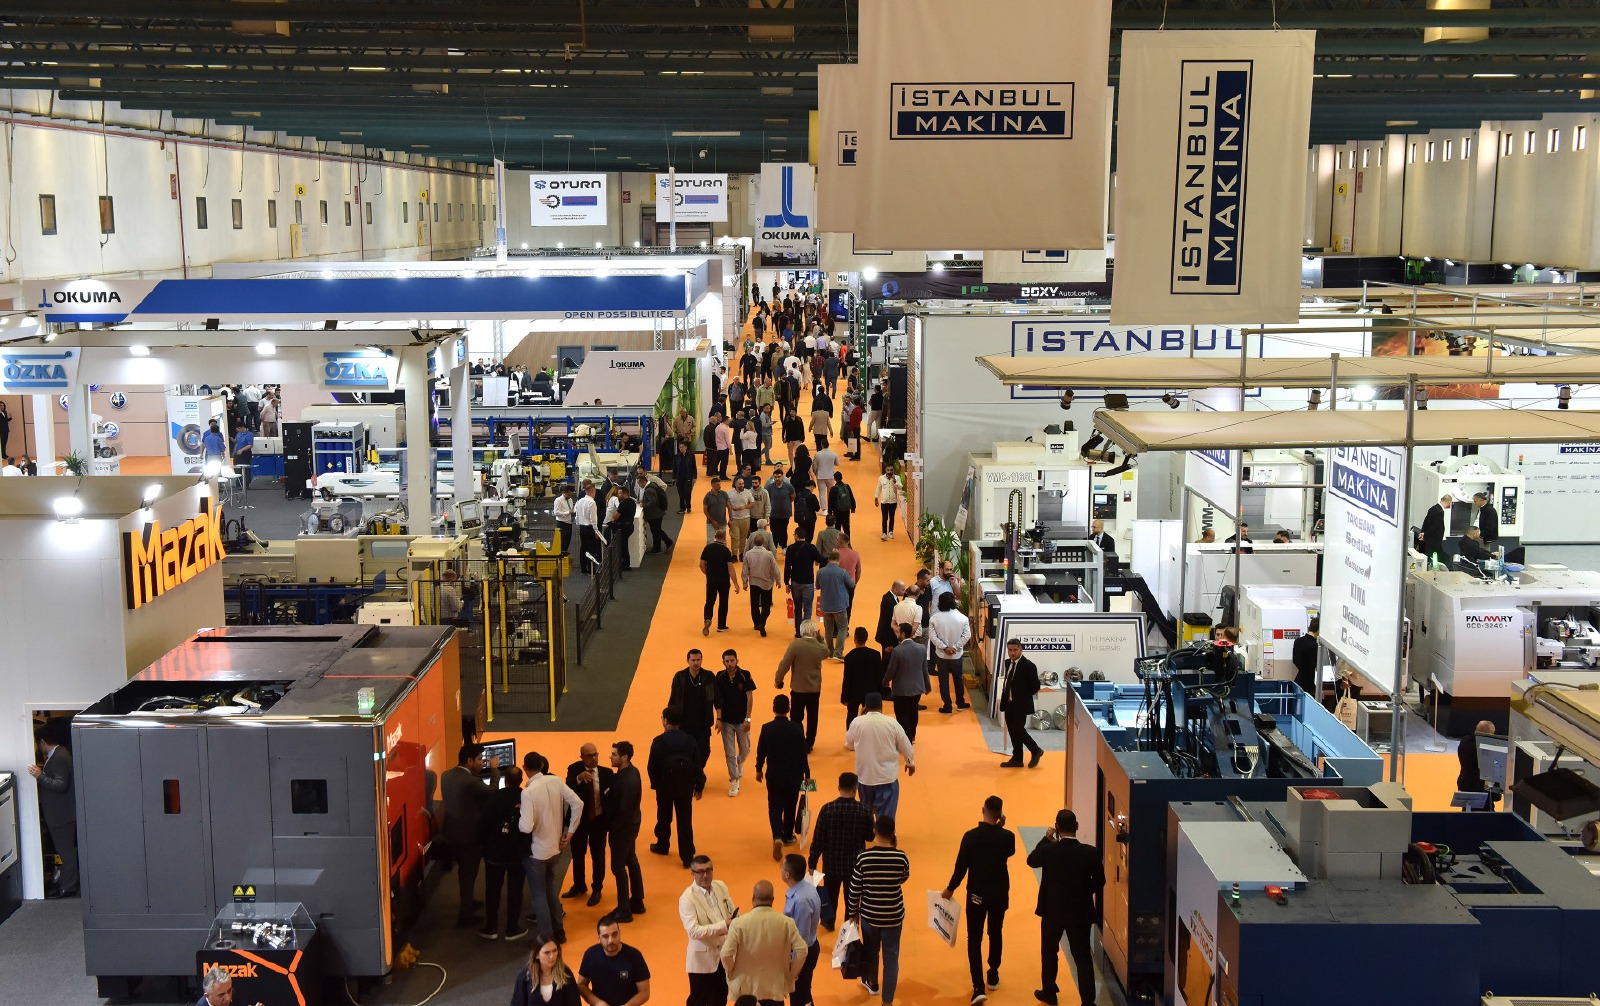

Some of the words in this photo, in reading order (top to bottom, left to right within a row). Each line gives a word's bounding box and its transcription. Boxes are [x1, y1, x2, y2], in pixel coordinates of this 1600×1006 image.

[901, 87, 1061, 107] İSTANBUL
[915, 112, 1048, 132] MAKİNA
[549, 180, 602, 189] OTURN
[1177, 75, 1210, 281] İSTANBUL
[1213, 93, 1242, 261] MAKİNA
[298, 187, 304, 195] 8
[1338, 185, 1344, 194] 6
[761, 231, 811, 241] OKUMA
[53, 291, 122, 304] OKUMA
[564, 311, 594, 319] OPEN
[597, 310, 675, 319] POSSIBILITIES
[1027, 327, 1242, 352] İSTANBUL
[3, 359, 68, 380] ÖZKA
[324, 357, 388, 380] ÖZKA
[1337, 468, 1389, 511] MAKİNA
[123, 496, 227, 610] Mazak
[1023, 643, 1068, 651] MAKİNA
